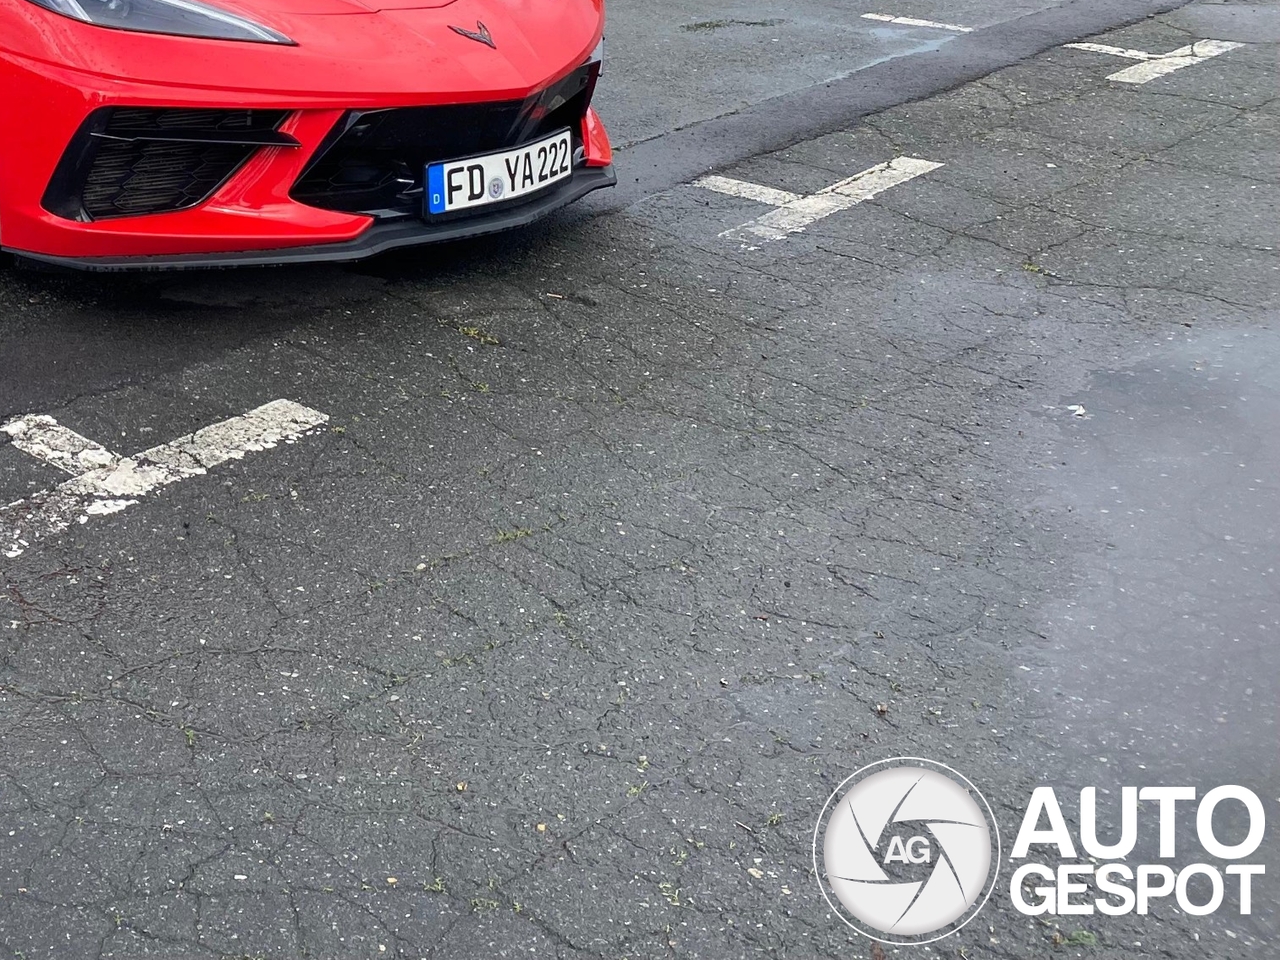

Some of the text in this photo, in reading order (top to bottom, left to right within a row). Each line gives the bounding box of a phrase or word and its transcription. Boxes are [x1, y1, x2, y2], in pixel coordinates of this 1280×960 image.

[446, 138, 569, 205] FD YA 222
[433, 193, 440, 205] D
